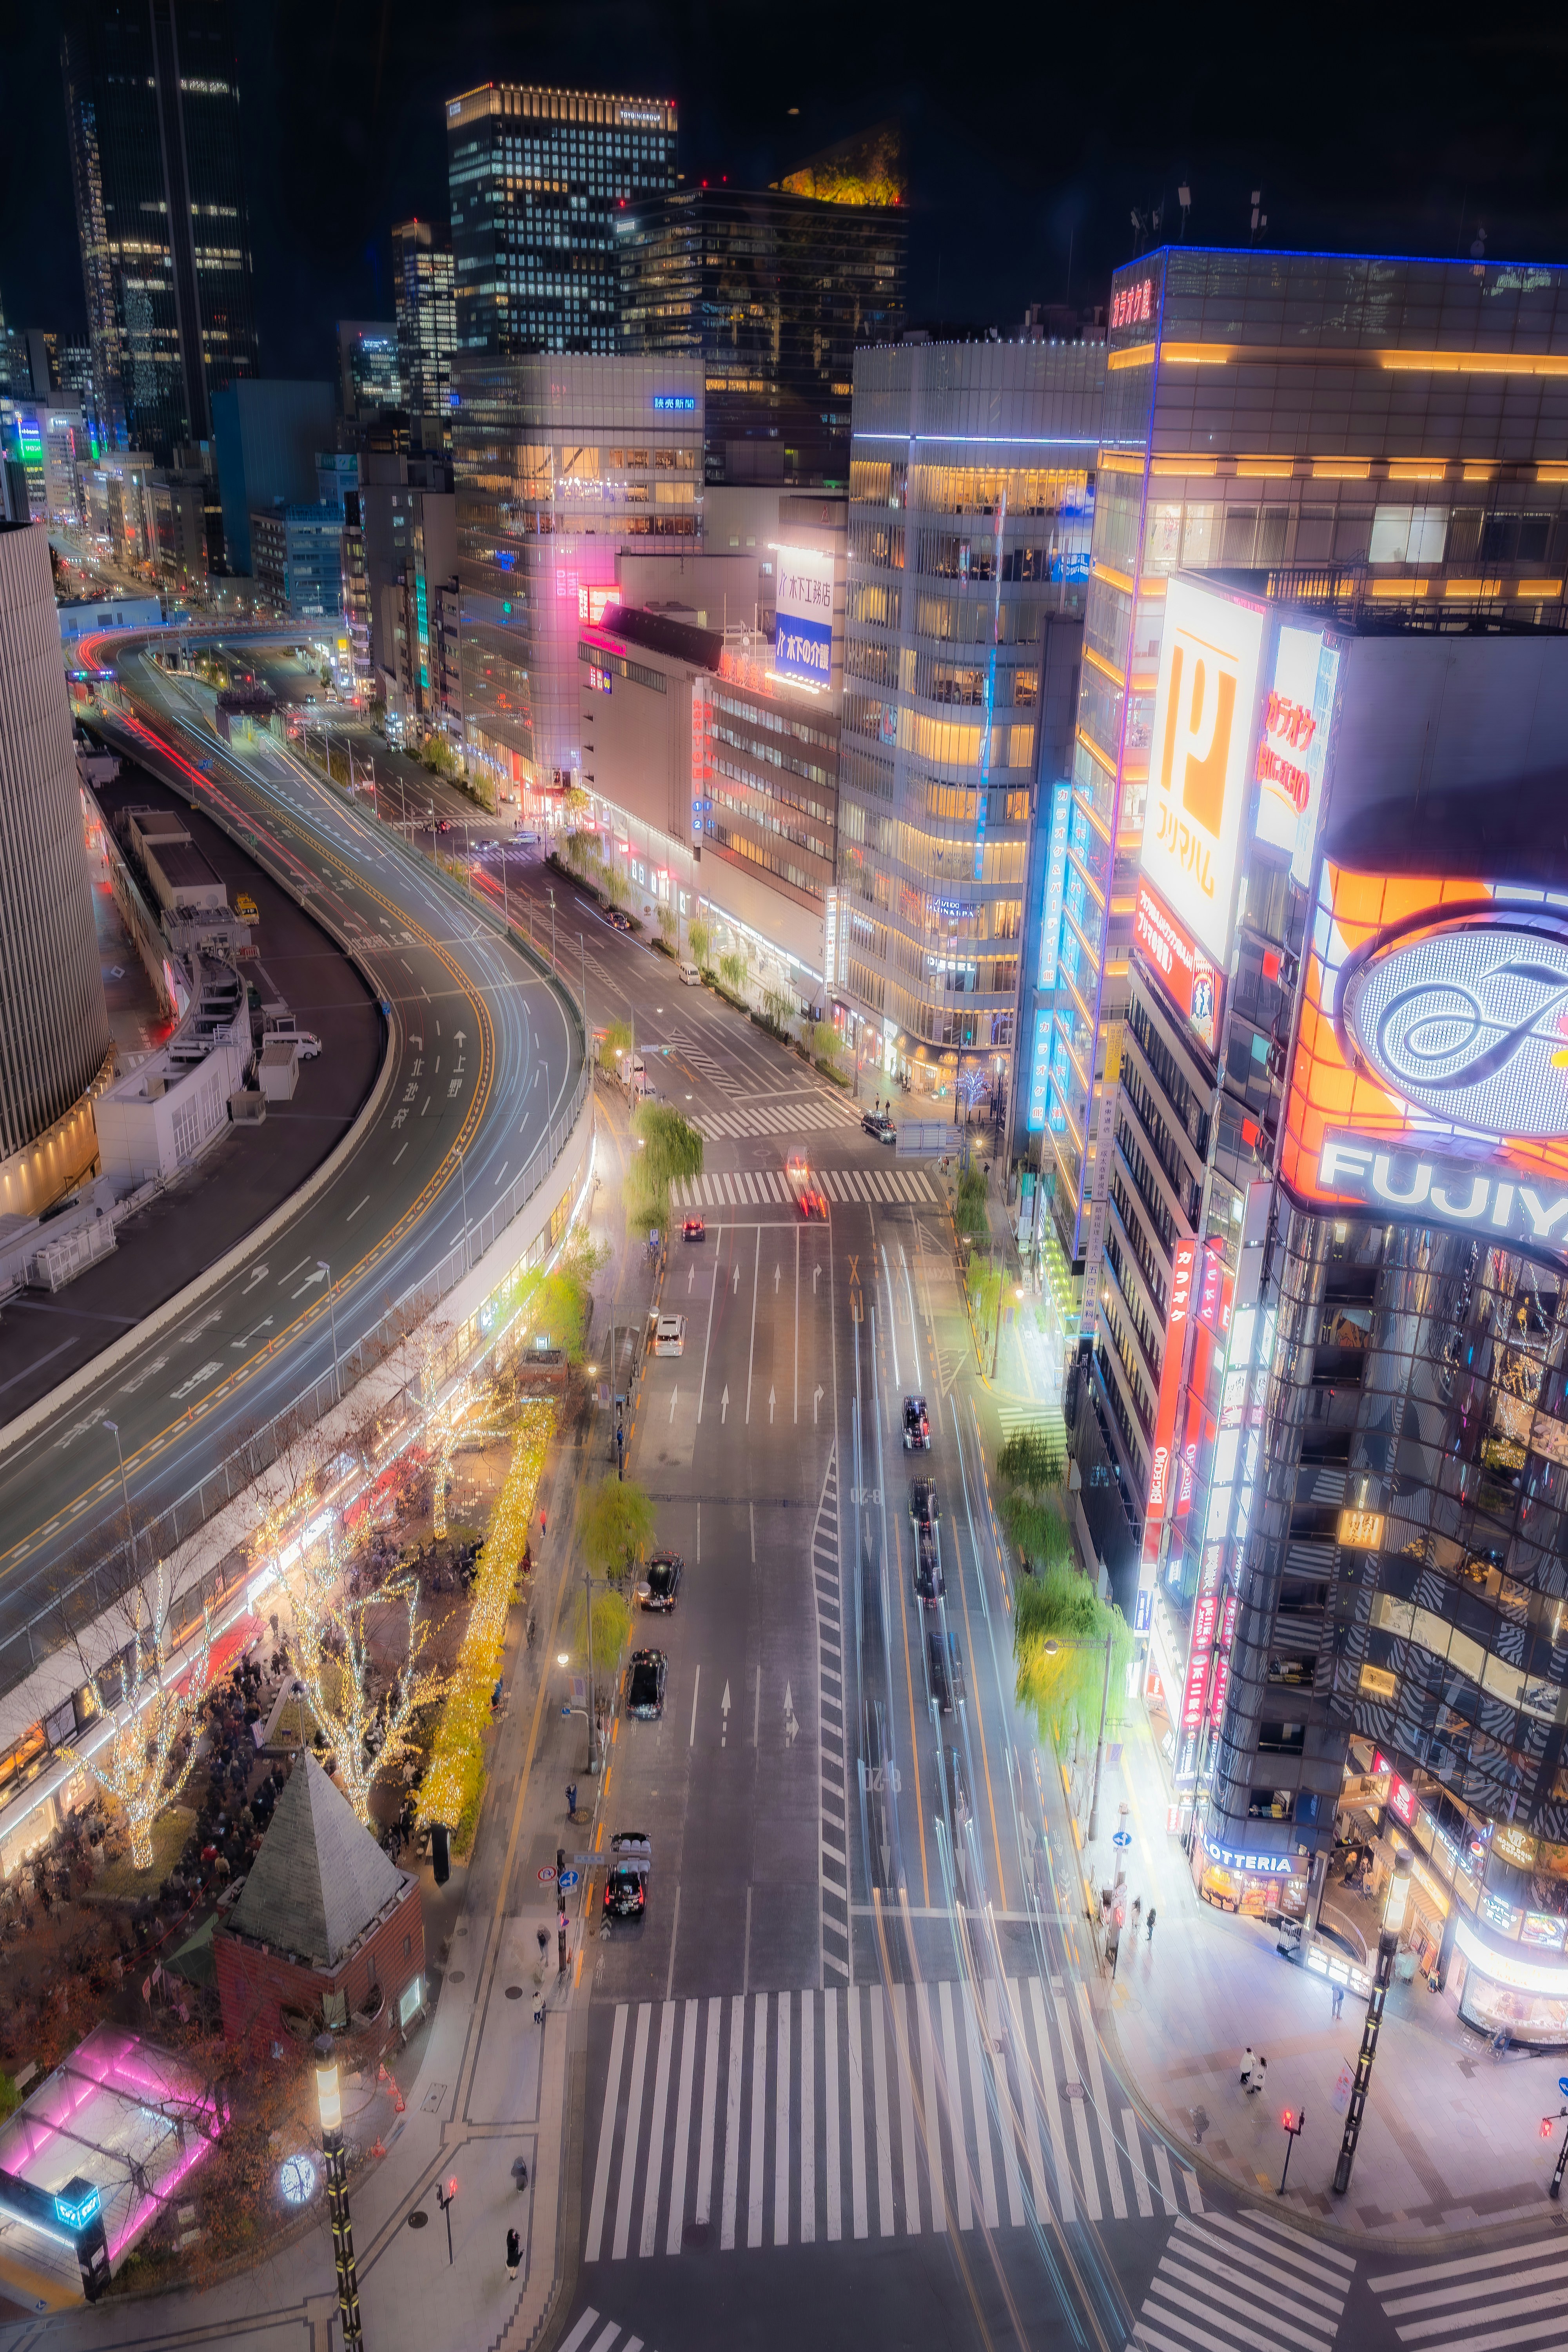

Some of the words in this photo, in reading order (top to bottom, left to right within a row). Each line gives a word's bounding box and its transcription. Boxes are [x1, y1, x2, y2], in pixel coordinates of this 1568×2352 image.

[1112, 279, 1151, 328] カラオケ館
[789, 575, 830, 606] 木下工務店
[787, 634, 829, 671] 木下の介護
[604, 677, 610, 689] GU
[693, 699, 702, 730] 丸の内
[1265, 691, 1316, 752] カラオケ
[692, 735, 703, 795] TOEI
[1257, 740, 1280, 782] BIG
[1280, 761, 1310, 813] ECHO
[927, 955, 975, 972] DIESEL
[1107, 1029, 1116, 1071] BREITLING
[447, 1054, 466, 1098] 上野
[1032, 1021, 1050, 1121] カラオケ館
[390, 1058, 425, 1129] 北池袋
[1103, 1099, 1112, 1134] 新東通信
[1097, 1149, 1108, 1198] 塚本商事機械
[1091, 1206, 1102, 1257] 銀座税理士法人
[1084, 1265, 1098, 1318] 五百住歯科
[1171, 1251, 1192, 1322] カラオケ
[1153, 1446, 1168, 1481] ECHO
[850, 1488, 882, 1504] 8-20
[1150, 1481, 1163, 1504] BIG
[1203, 1607, 1214, 1636] 不二家
[1188, 1667, 1204, 1710] 不二家
[1203, 1832, 1292, 1873] LOTTERIA
[1496, 1834, 1516, 1852] HAND
[1515, 1847, 1533, 1862] DRIP
[1501, 1843, 1526, 1864] COFFEE
